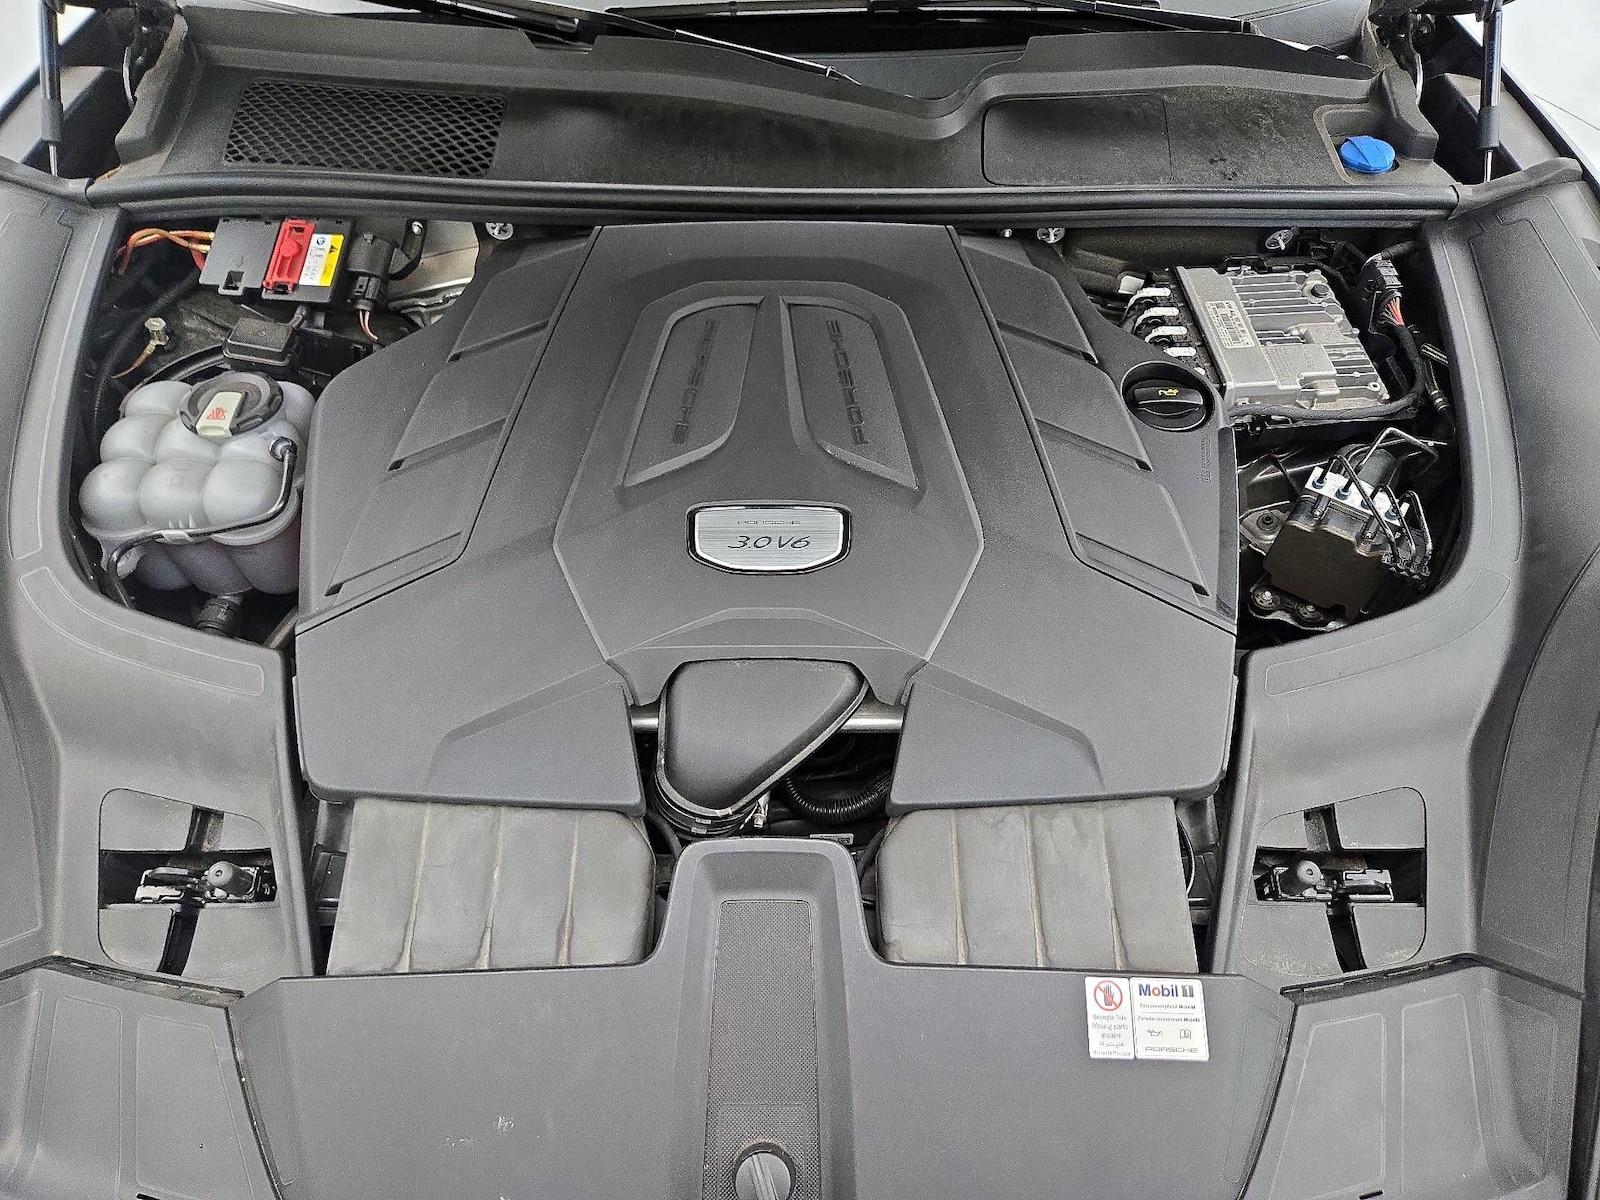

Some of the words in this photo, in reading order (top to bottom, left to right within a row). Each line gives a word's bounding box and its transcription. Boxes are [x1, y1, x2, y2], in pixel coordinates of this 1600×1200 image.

[826, 320, 868, 445] PORSCHE
[727, 535, 773, 549] 3.0
[777, 535, 811, 549] V6
[1138, 984, 1178, 997] Mobil
[1182, 985, 1194, 997] 1
[1092, 1022, 1112, 1030] Moving
